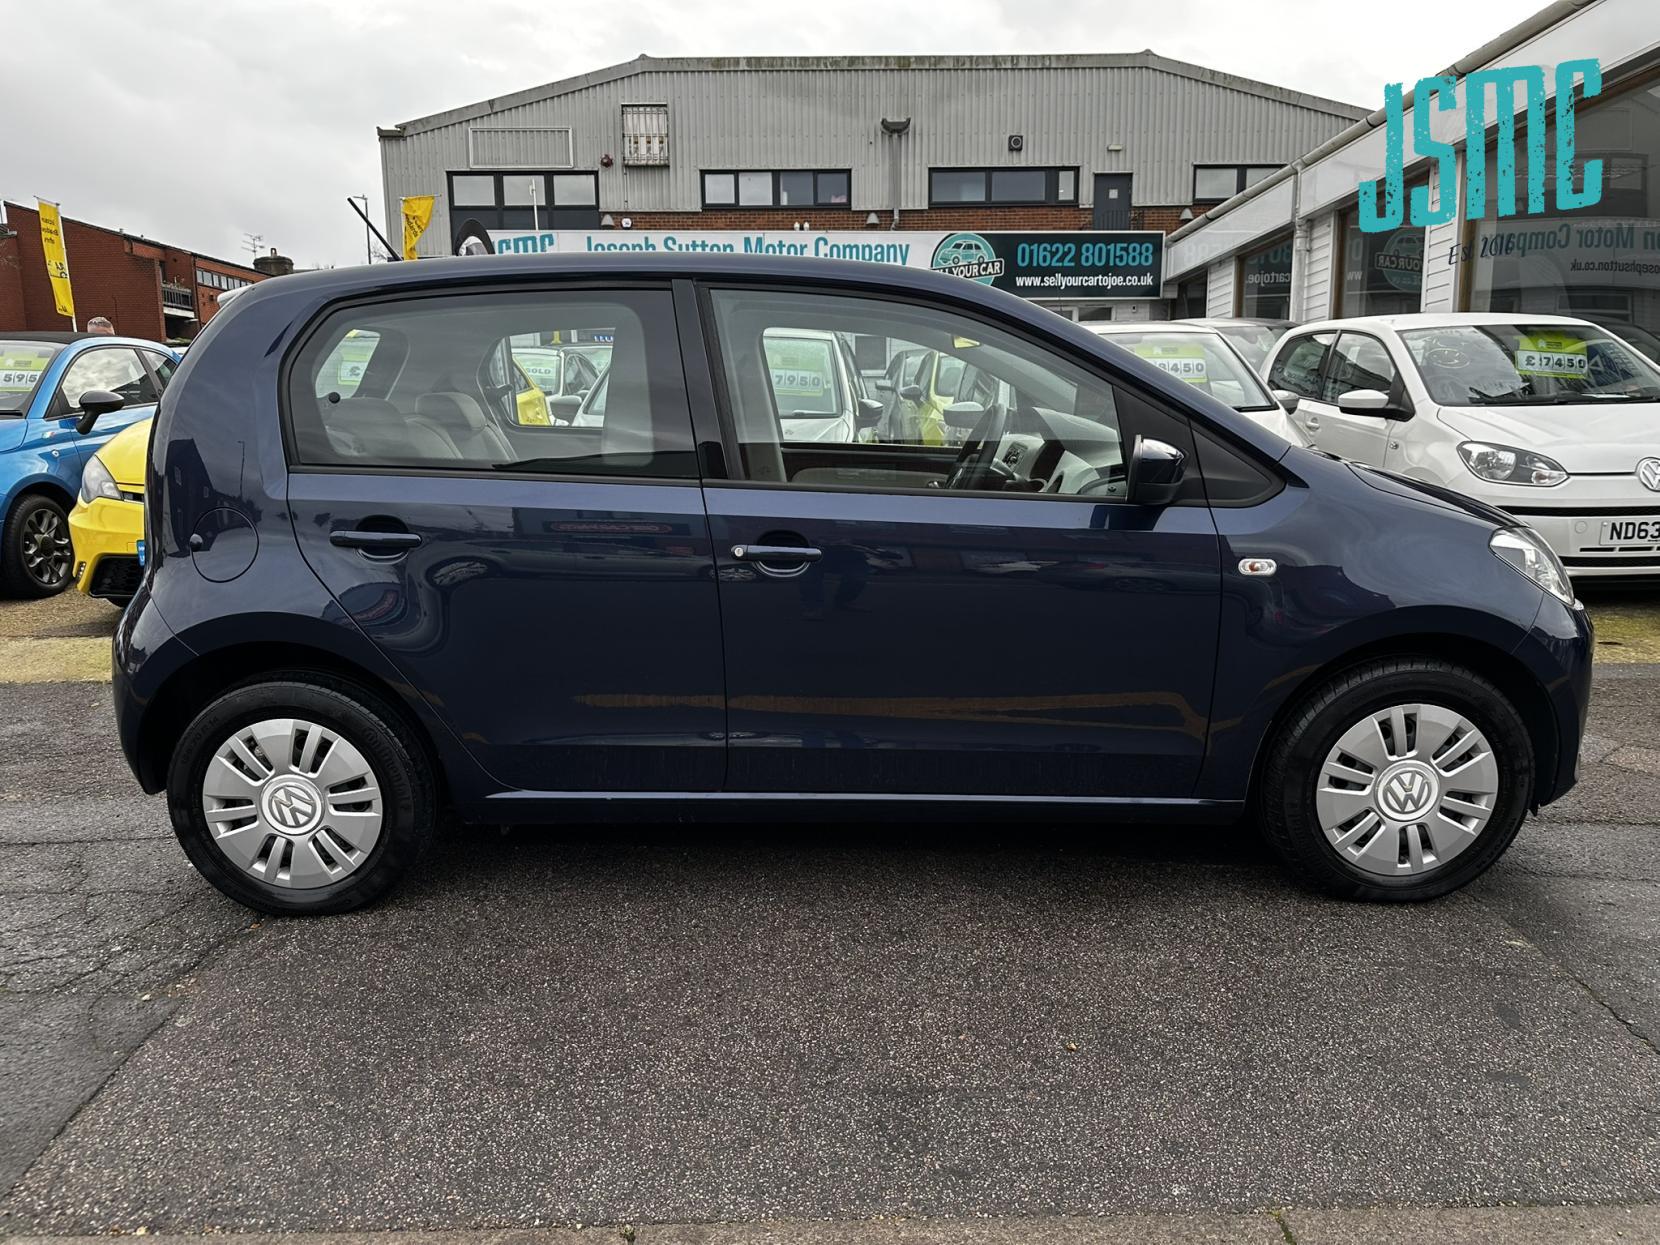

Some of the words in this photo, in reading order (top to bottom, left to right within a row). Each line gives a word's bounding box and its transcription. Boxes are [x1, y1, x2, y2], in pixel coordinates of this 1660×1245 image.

[743, 236, 808, 257] Motor
[814, 236, 910, 266] Company
[1017, 242, 1075, 267] 01622
[1081, 242, 1153, 267] 801588
[952, 264, 979, 278] YOUR
[980, 262, 1001, 275] CAR
[1015, 272, 1153, 290] www.sellyourcartojoe.co.uk
[1609, 521, 1660, 540] ND63
